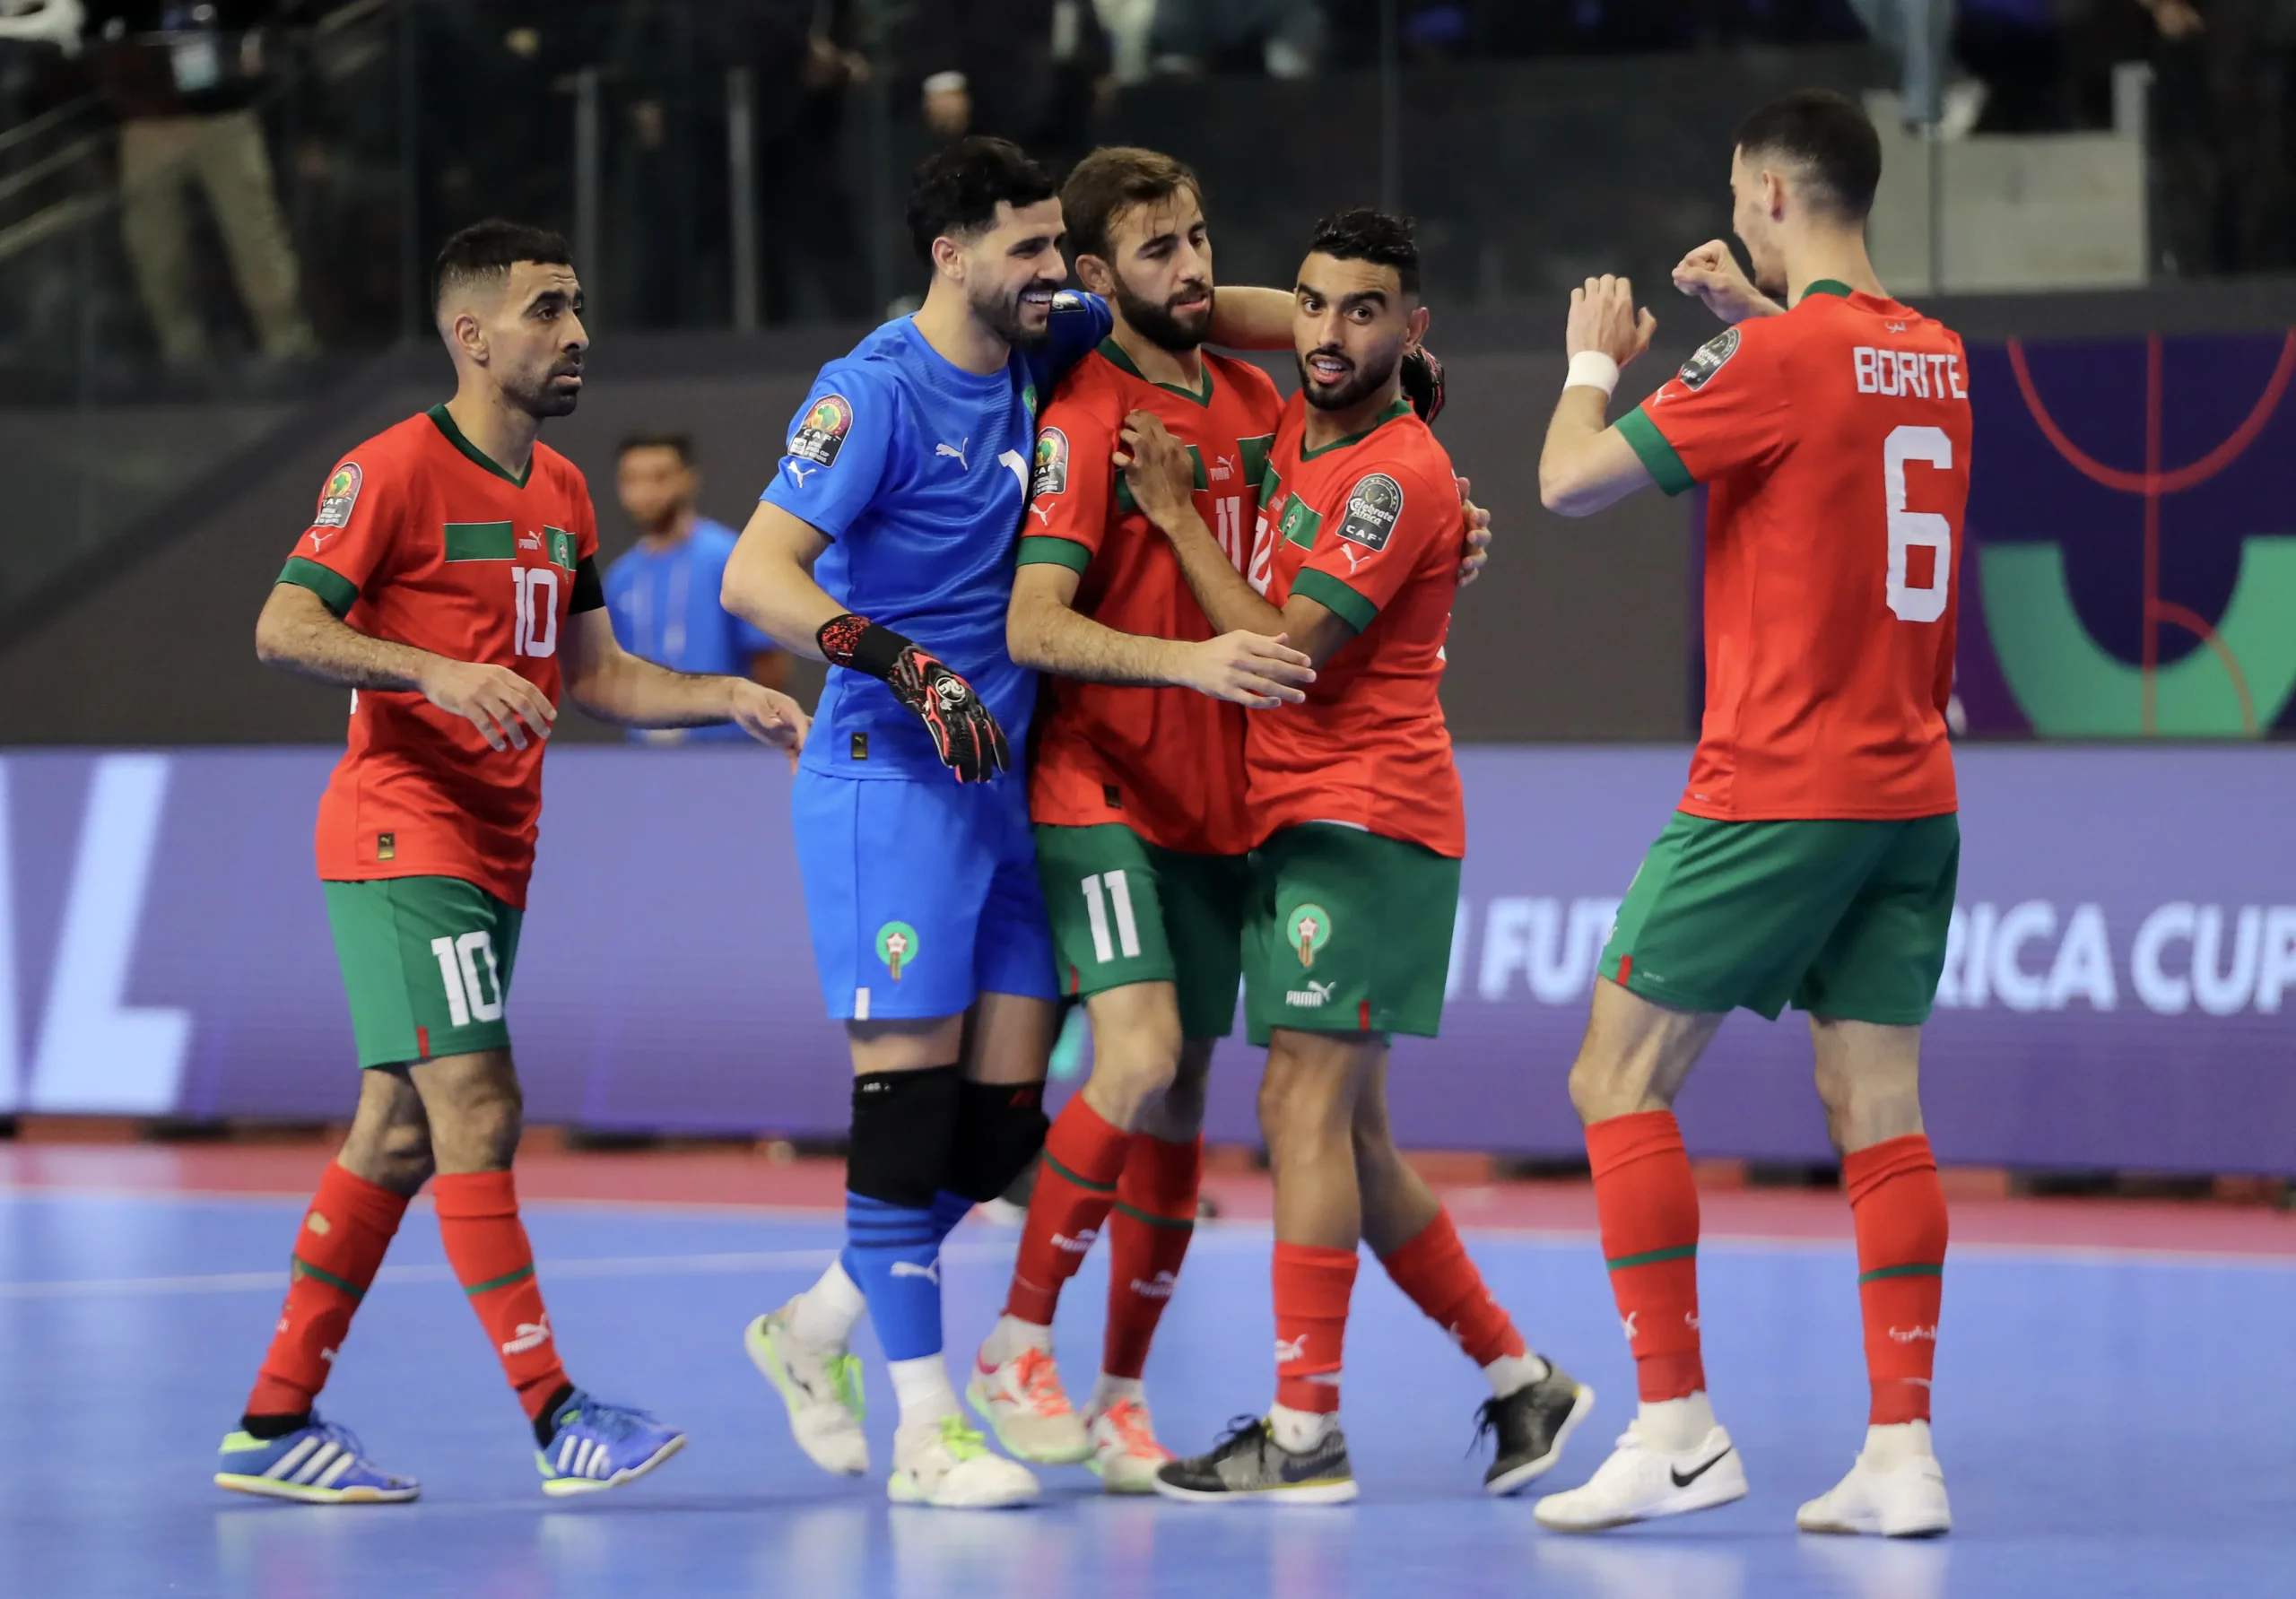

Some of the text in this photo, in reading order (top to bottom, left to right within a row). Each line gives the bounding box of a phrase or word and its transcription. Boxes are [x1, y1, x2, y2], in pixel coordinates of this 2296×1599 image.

[1853, 346, 1967, 399] BORITE
[803, 429, 832, 441] CAF
[1215, 496, 1241, 573] 11
[1345, 525, 1378, 541] CAF
[1349, 498, 1394, 522] Celebrate
[1351, 508, 1382, 525] Africa
[1884, 425, 1952, 622] 6
[511, 567, 558, 658] 10
[0, 753, 192, 1114] L
[1081, 869, 1141, 963] 11
[430, 931, 502, 1027] 10
[2130, 901, 2296, 1016] CUP
[1285, 990, 1322, 1007] PUMA
